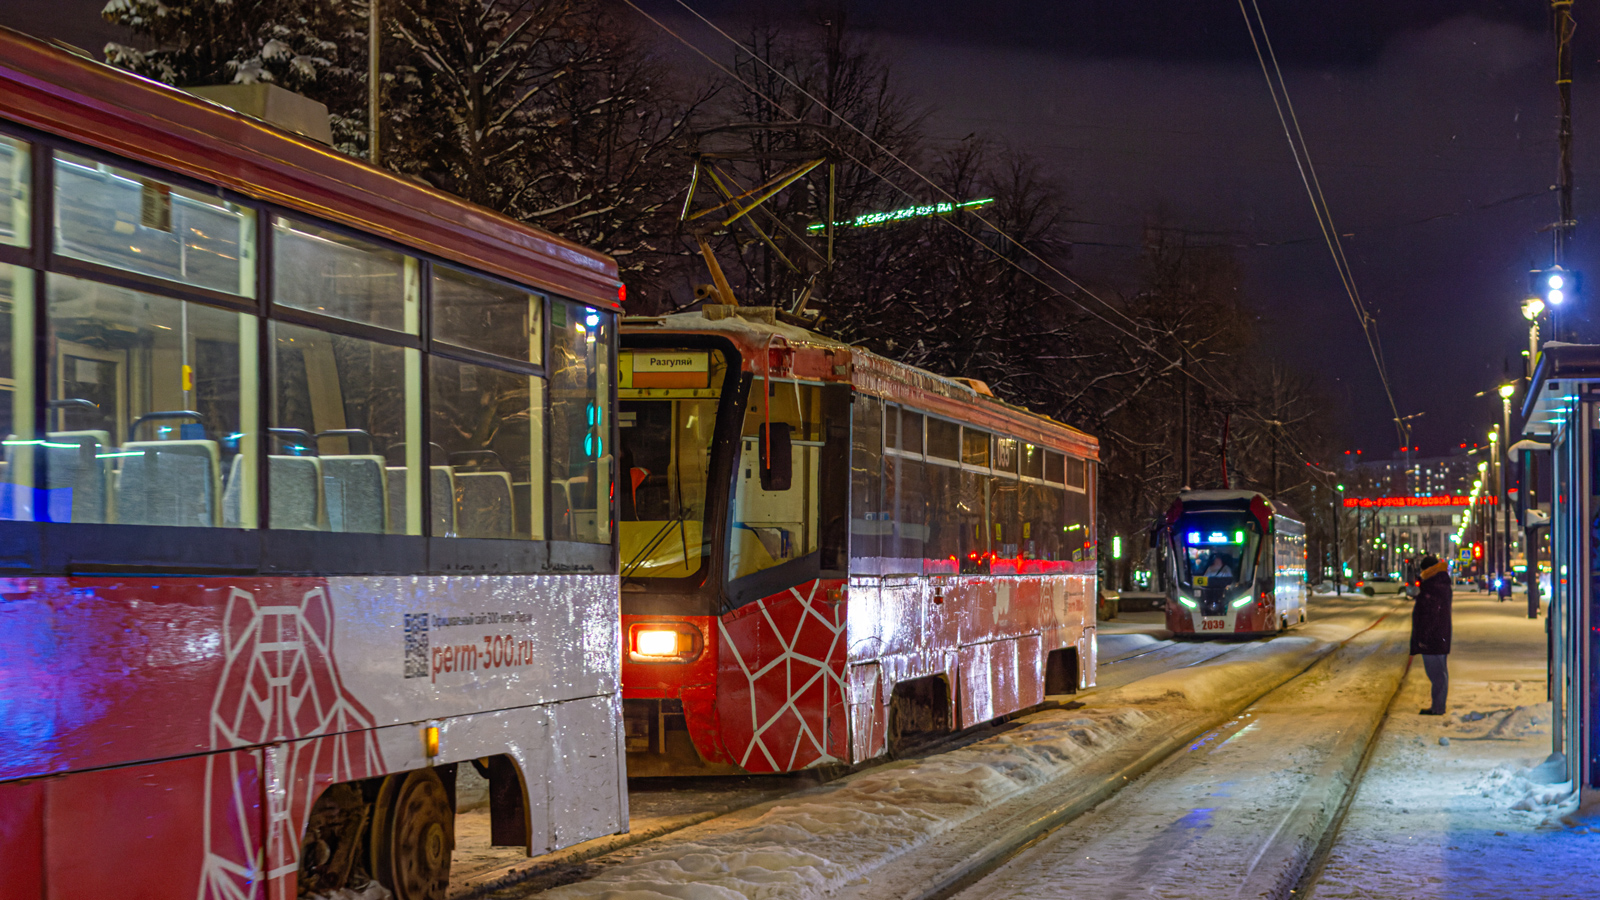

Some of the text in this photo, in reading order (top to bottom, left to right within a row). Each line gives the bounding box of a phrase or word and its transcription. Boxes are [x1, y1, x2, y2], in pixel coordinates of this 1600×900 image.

[650, 357, 692, 367] Разгуляй
[1405, 494, 1451, 507] ТРУДОВОЙ
[1197, 577, 1204, 585] 6
[475, 612, 487, 624] сайт
[1201, 619, 1225, 630] 2039
[431, 634, 533, 684] perm-300.ru
